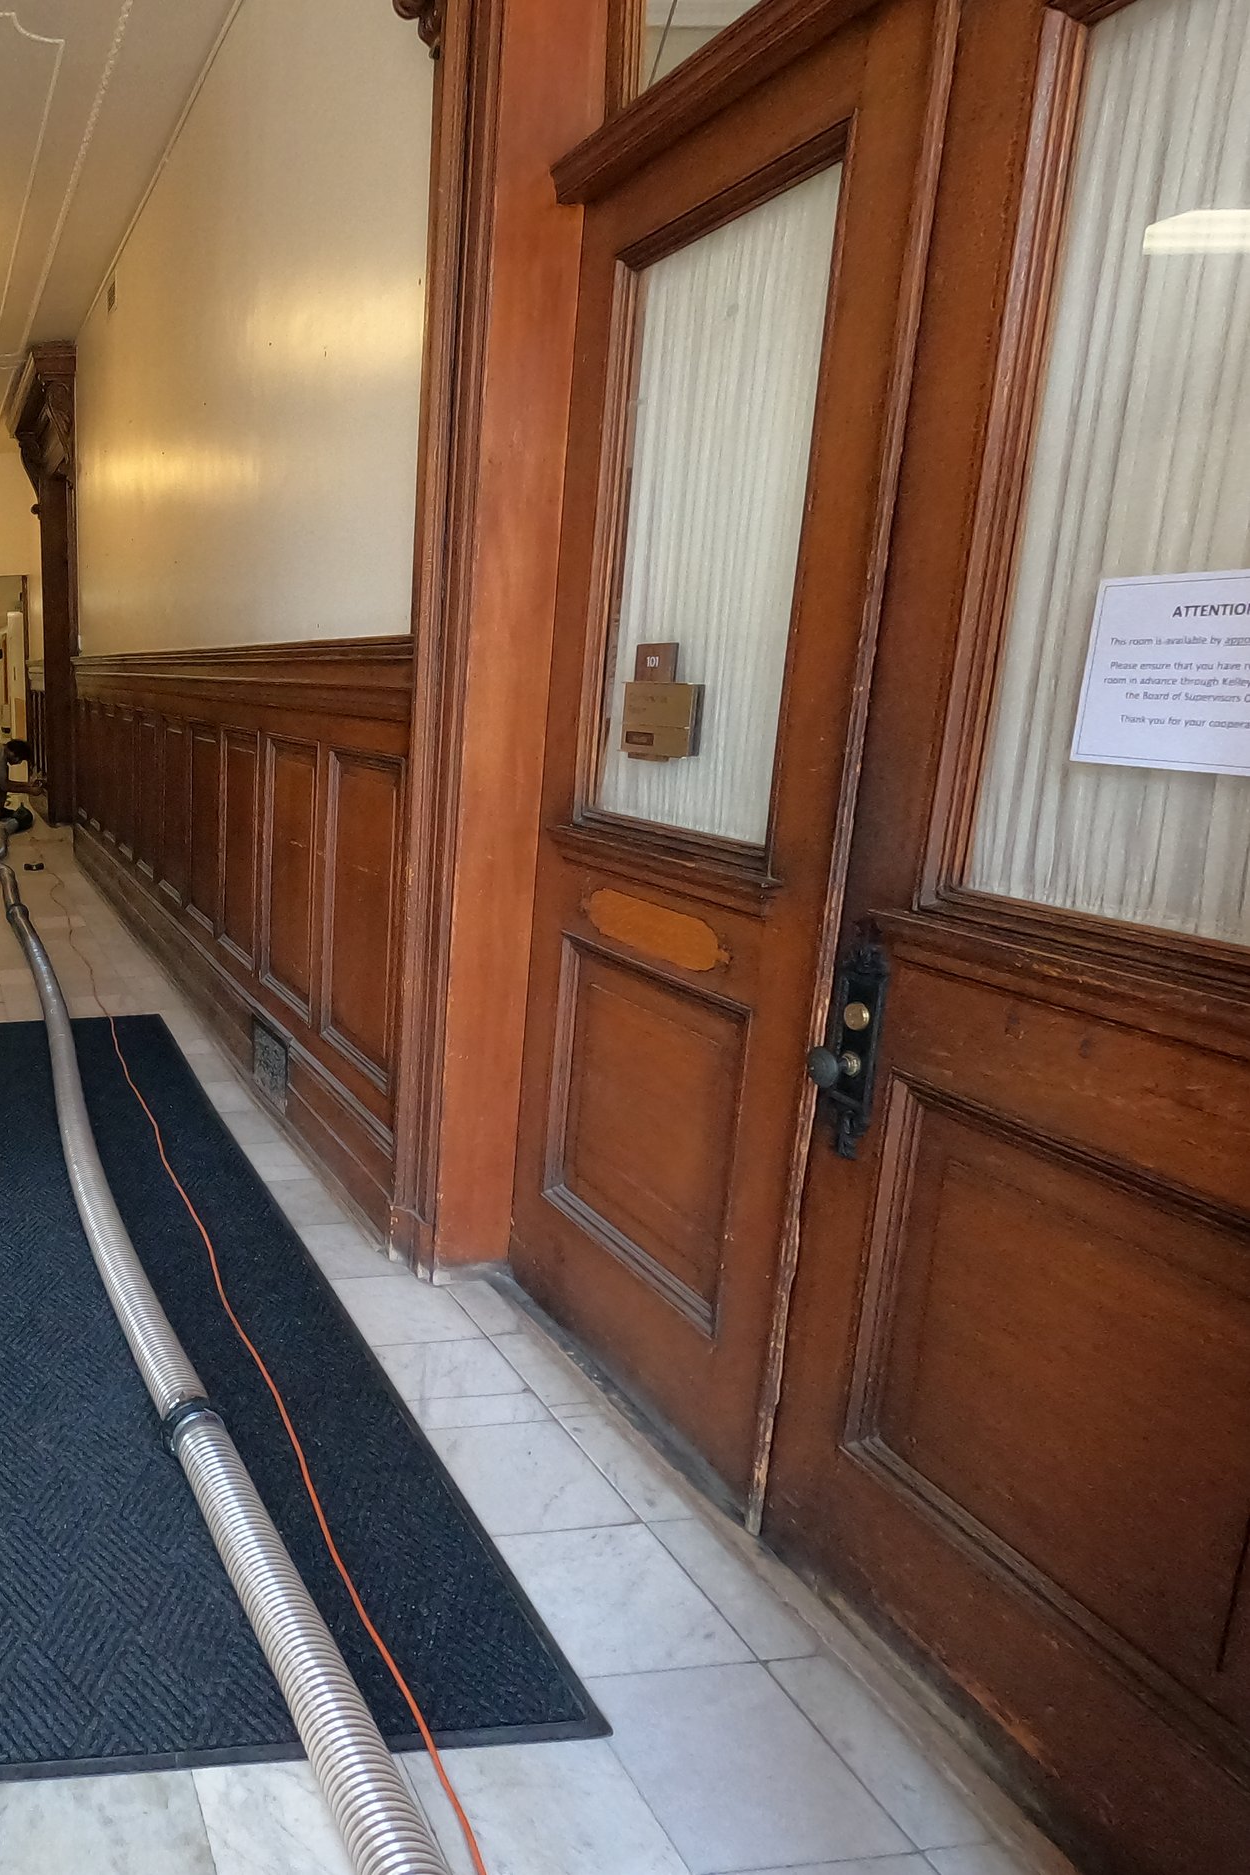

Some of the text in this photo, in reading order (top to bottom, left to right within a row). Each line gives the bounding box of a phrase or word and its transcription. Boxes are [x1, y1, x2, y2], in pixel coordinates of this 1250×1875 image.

[1172, 603, 1250, 617] ATTENTIO
[1110, 637, 1126, 646] This
[1129, 638, 1153, 646] room
[1155, 637, 1162, 646] is
[1166, 636, 1207, 645] available
[1209, 636, 1222, 647] by
[646, 656, 659, 667] 101
[1110, 661, 1137, 670] Please
[1140, 662, 1171, 670] ensure
[1174, 661, 1193, 670] that
[1196, 662, 1214, 672] you
[1217, 661, 1241, 670] have
[1103, 677, 1126, 685] room
[1129, 677, 1137, 685] in
[1140, 676, 1176, 686] advance
[1180, 676, 1218, 688] through
[1125, 691, 1140, 700] the
[1142, 691, 1169, 700] Board
[1172, 691, 1183, 700] of
[1185, 692, 1241, 702] Supervisors
[1120, 714, 1146, 723] Thank
[1149, 716, 1165, 726] you
[1168, 716, 1182, 726] for
[1184, 718, 1206, 728] your
